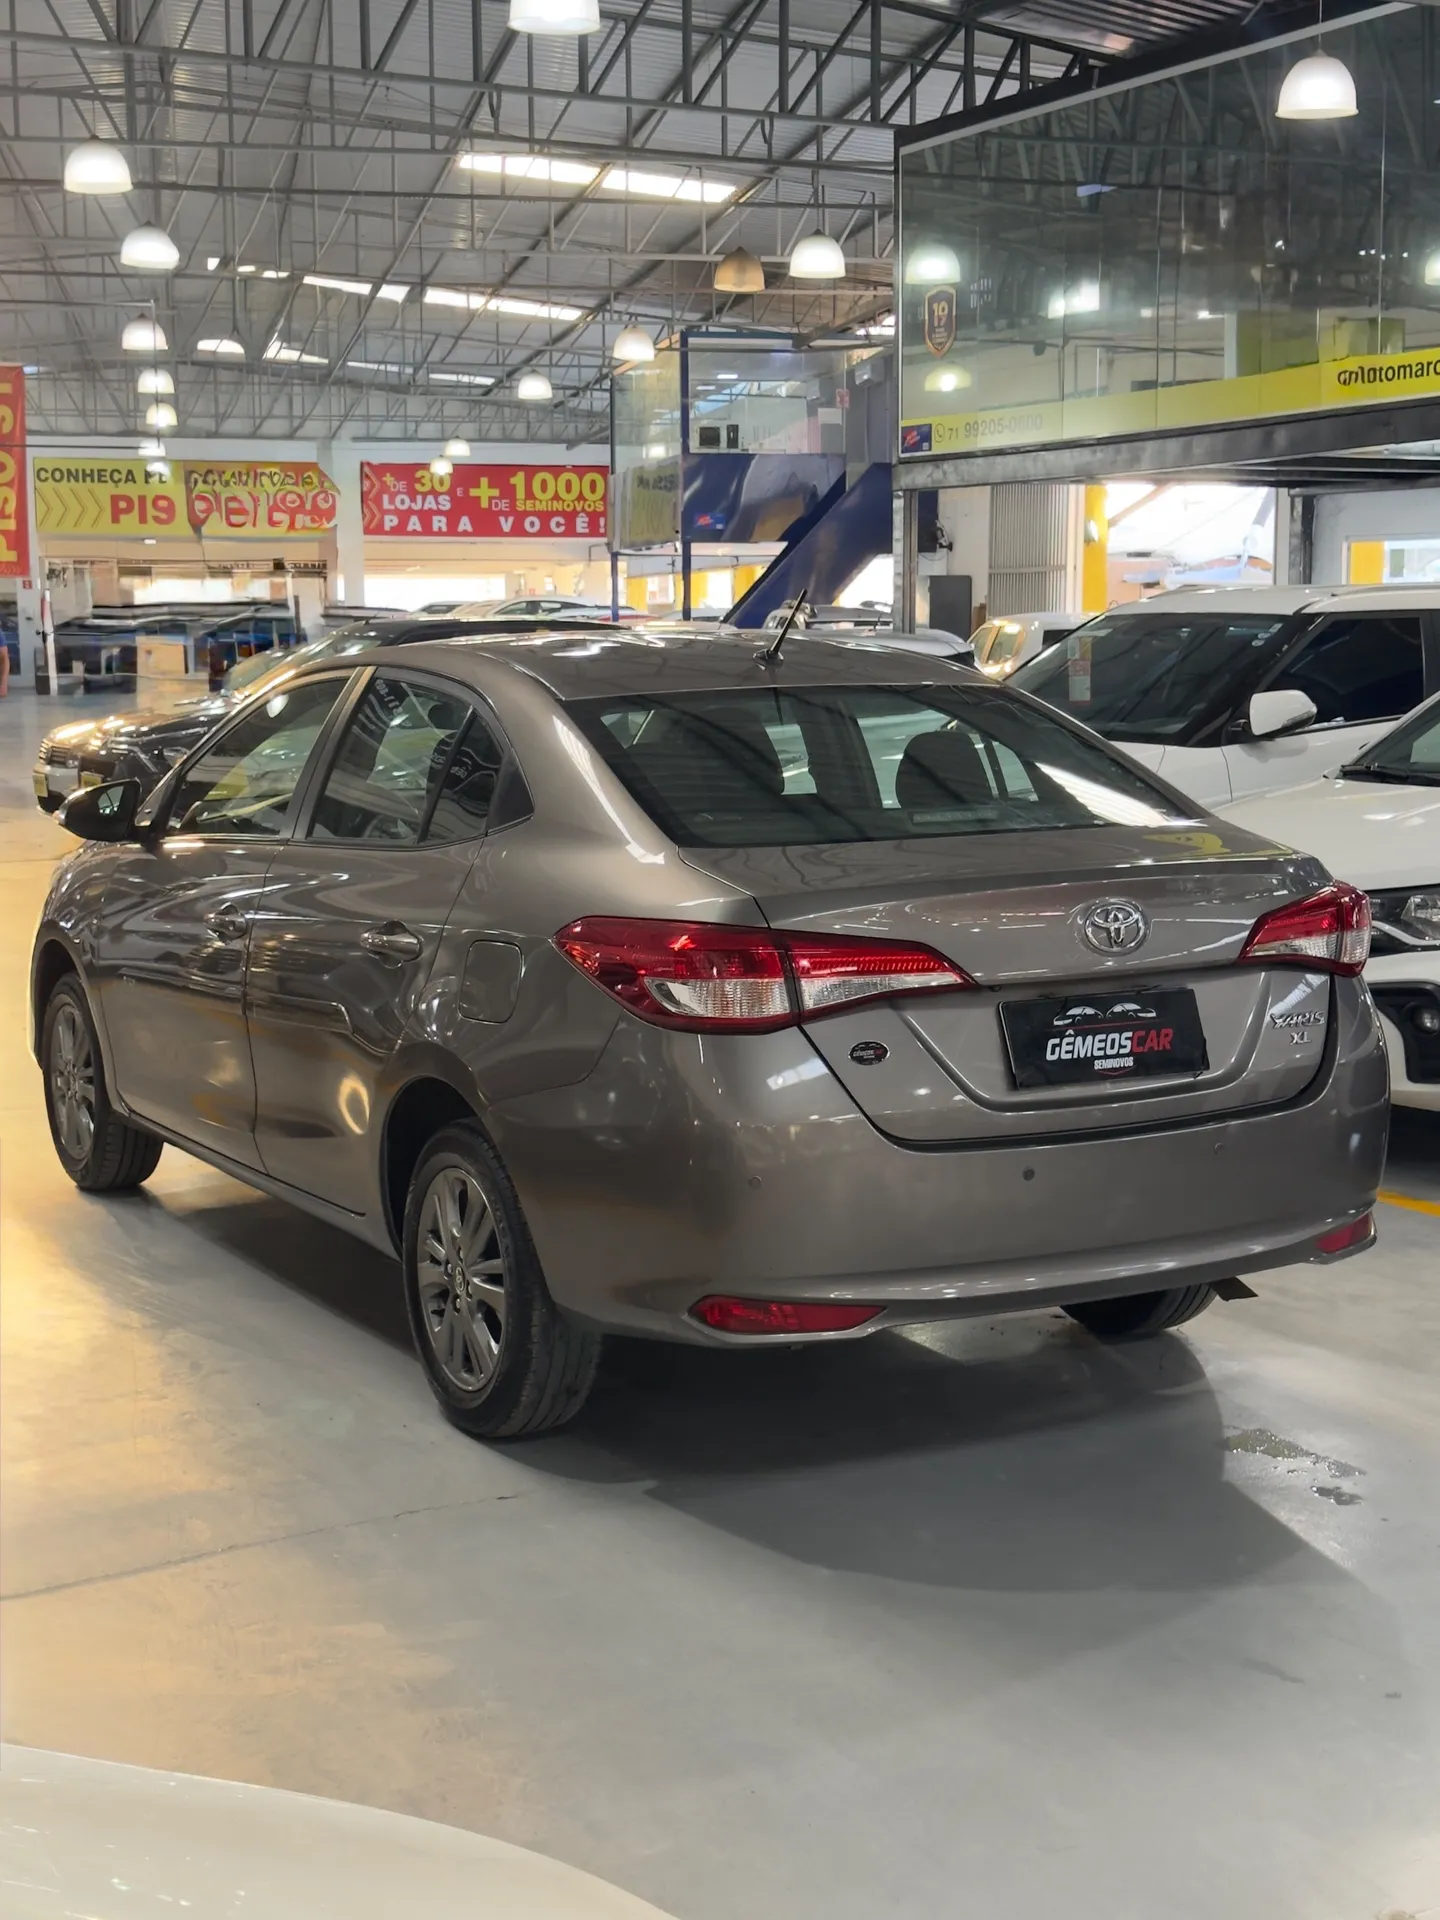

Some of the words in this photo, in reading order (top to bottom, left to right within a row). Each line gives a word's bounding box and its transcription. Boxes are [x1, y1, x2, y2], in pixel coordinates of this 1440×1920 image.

[947, 428, 959, 440] 71
[36, 467, 137, 488] CONHEÇA
[390, 481, 407, 492] DE
[414, 470, 451, 493] 30
[456, 487, 464, 497] E
[509, 471, 605, 501] 1000
[382, 494, 452, 511] LOJAS
[491, 500, 510, 511] DE
[516, 500, 605, 512] SEMINOVOS
[383, 515, 473, 532] PARA
[498, 512, 606, 534] VOCÊ!
[1046, 1029, 1174, 1061] GÊMEOSCAR
[1094, 1057, 1134, 1070] SEMINOVOS
